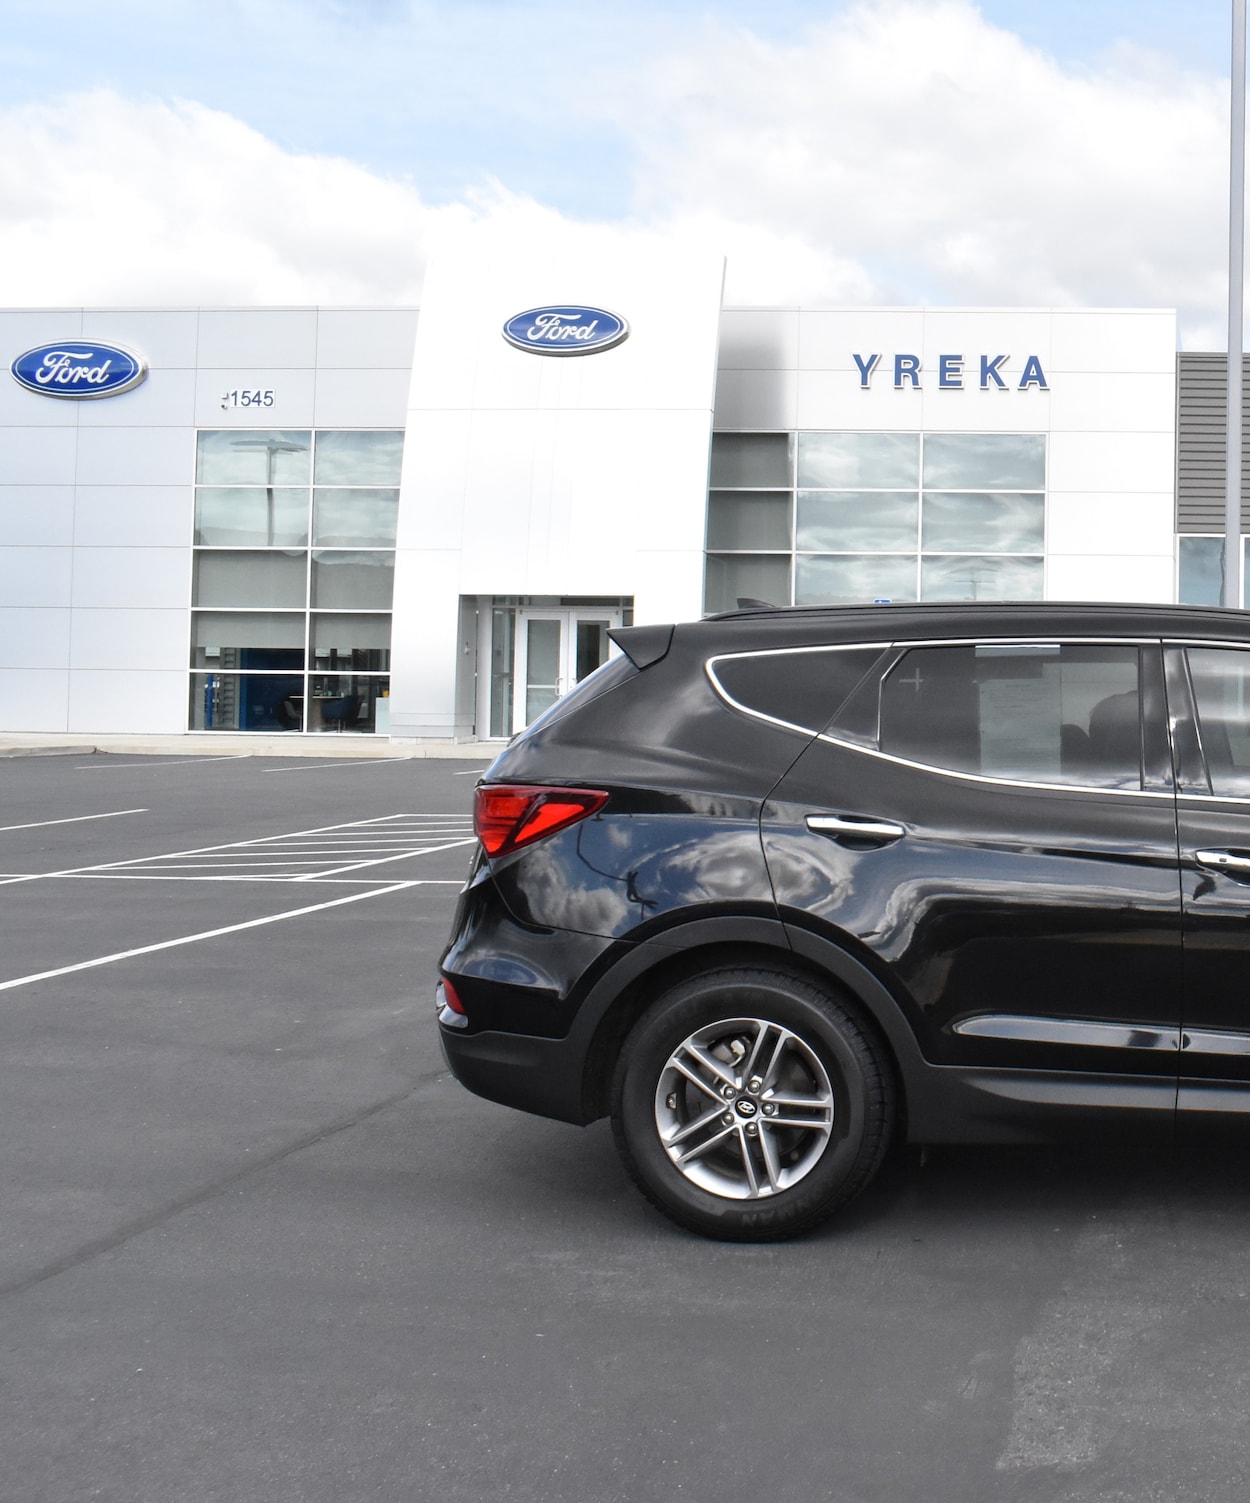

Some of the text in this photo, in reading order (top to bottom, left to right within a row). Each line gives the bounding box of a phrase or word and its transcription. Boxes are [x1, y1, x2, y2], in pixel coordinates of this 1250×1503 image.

[527, 313, 599, 340] Ford
[35, 351, 112, 384] Ford
[852, 353, 1050, 390] YREKA
[231, 390, 274, 407] 1545
